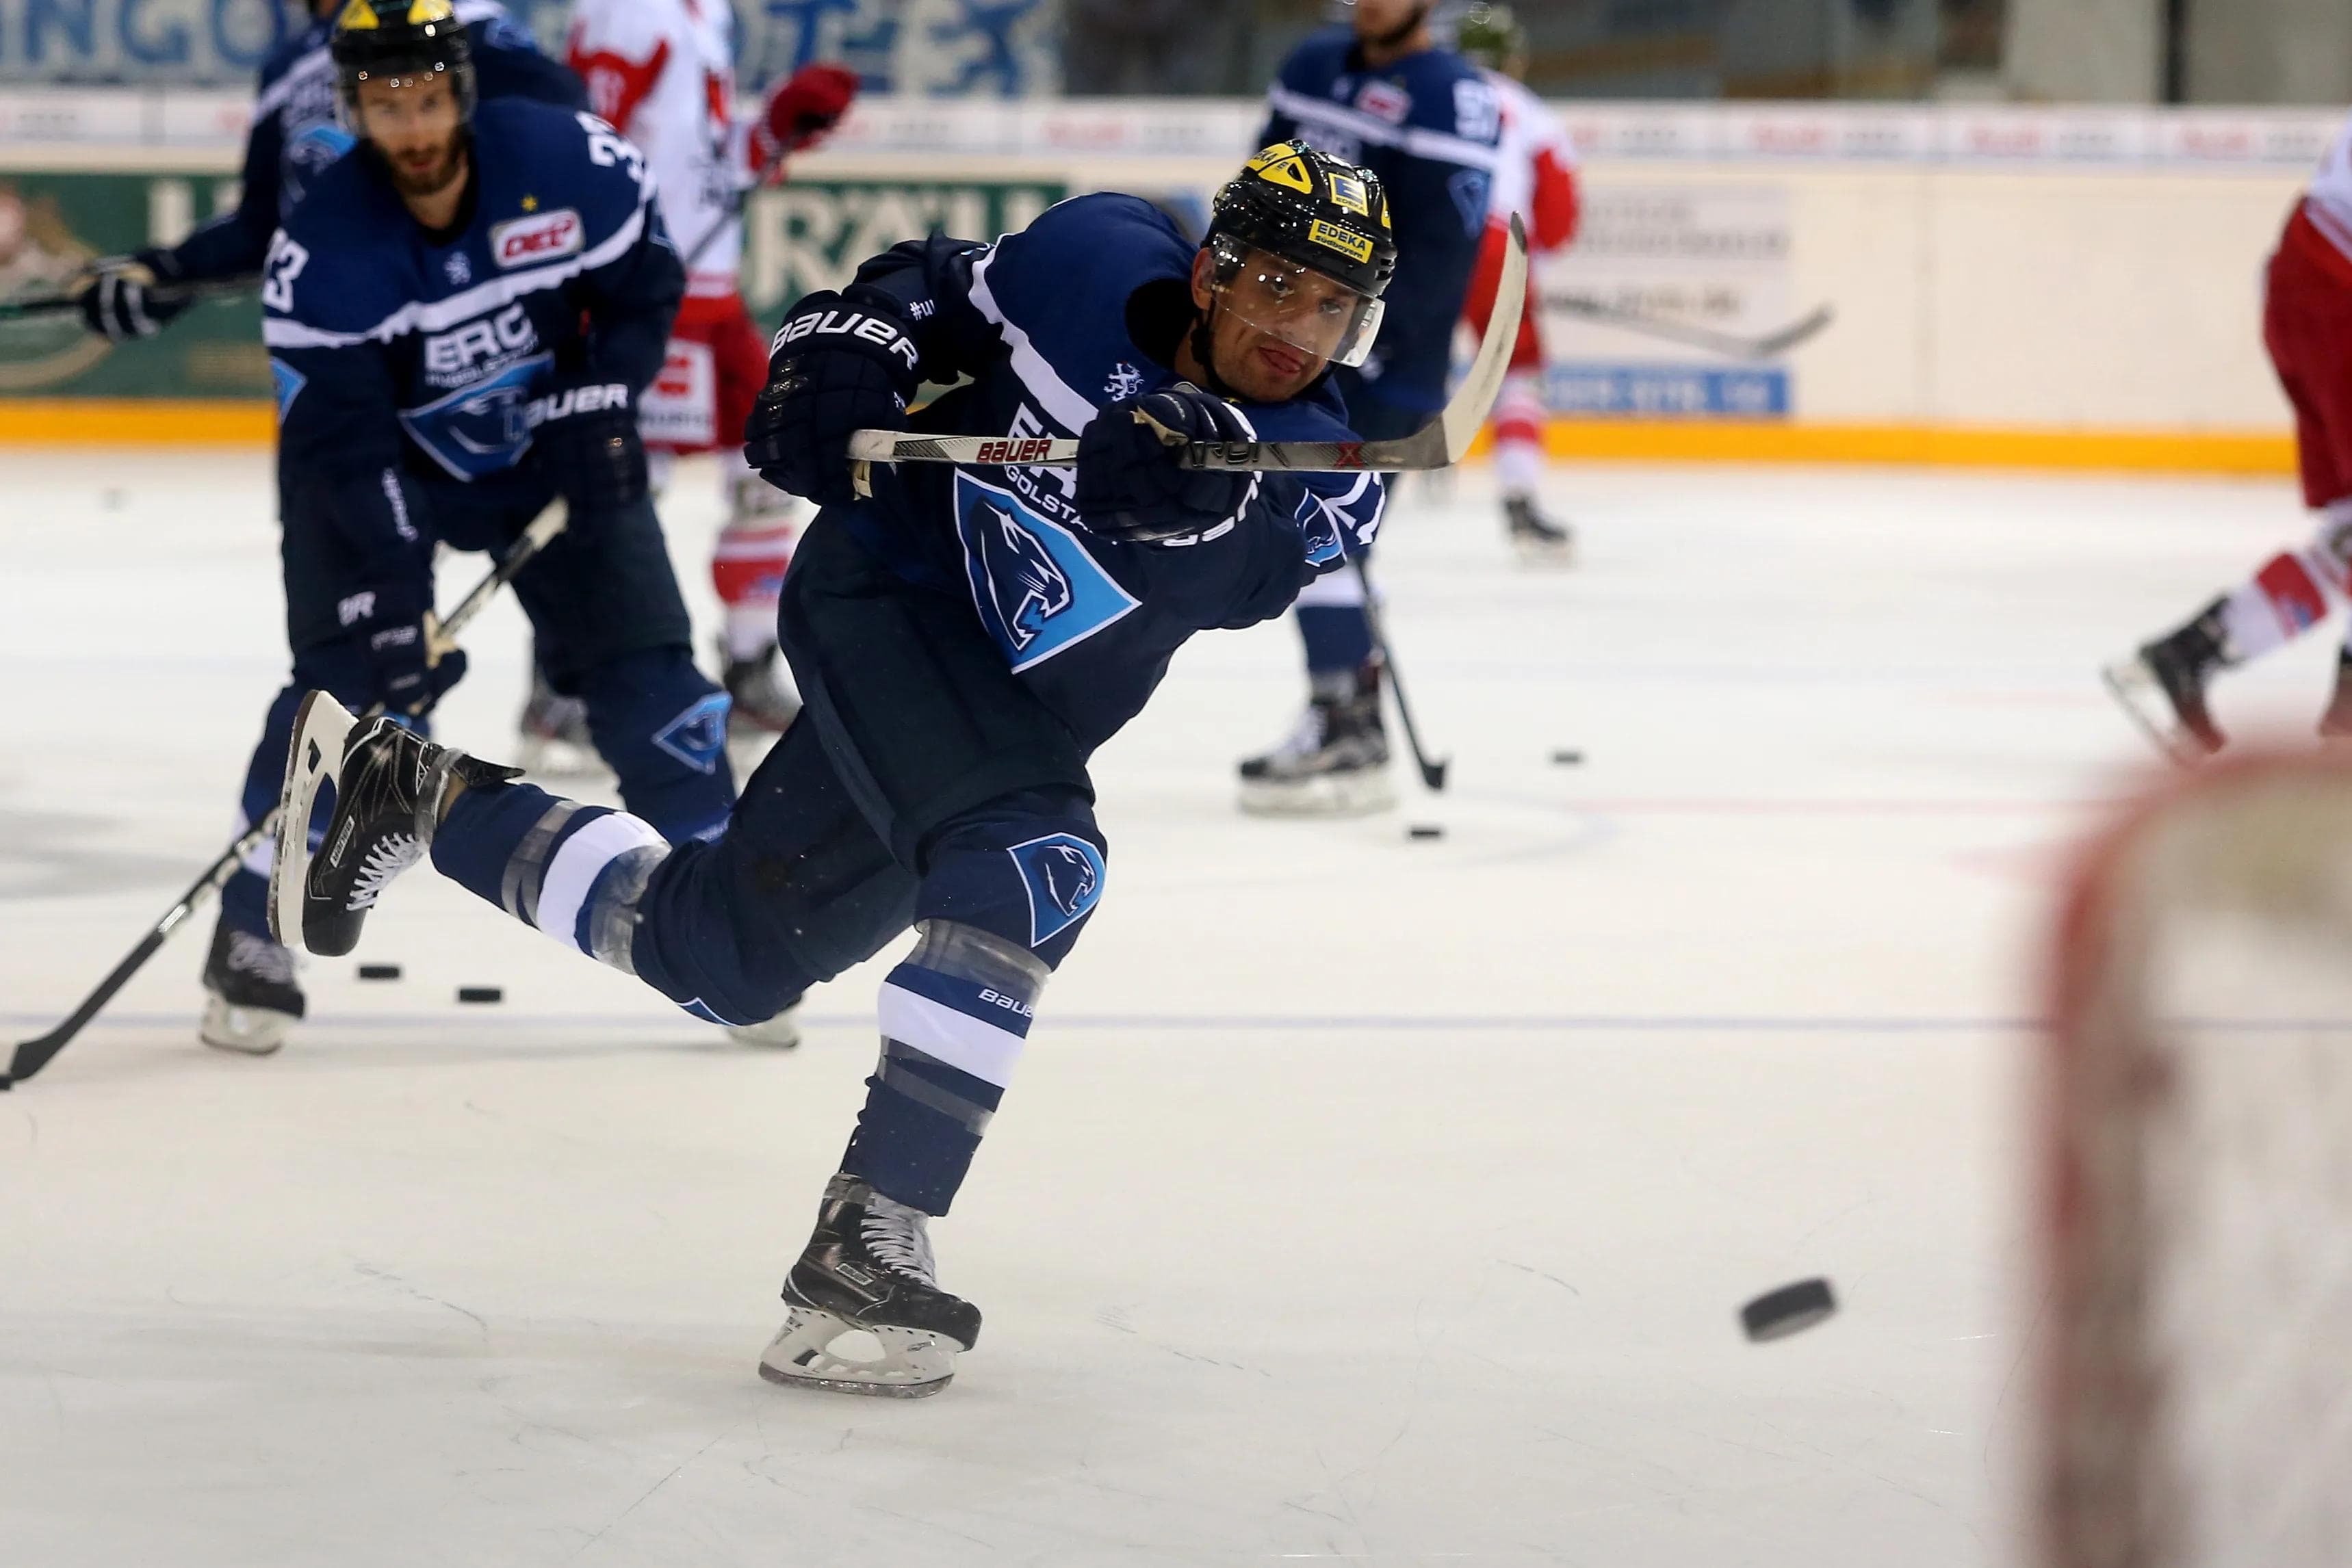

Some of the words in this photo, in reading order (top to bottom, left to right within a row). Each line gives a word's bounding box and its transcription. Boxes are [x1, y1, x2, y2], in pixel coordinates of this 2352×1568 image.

[1318, 223, 1367, 252] EDEKA
[424, 302, 534, 371] ERC
[769, 311, 919, 371] BAUER
[522, 382, 630, 430] AUER
[977, 439, 1052, 462] BAUER
